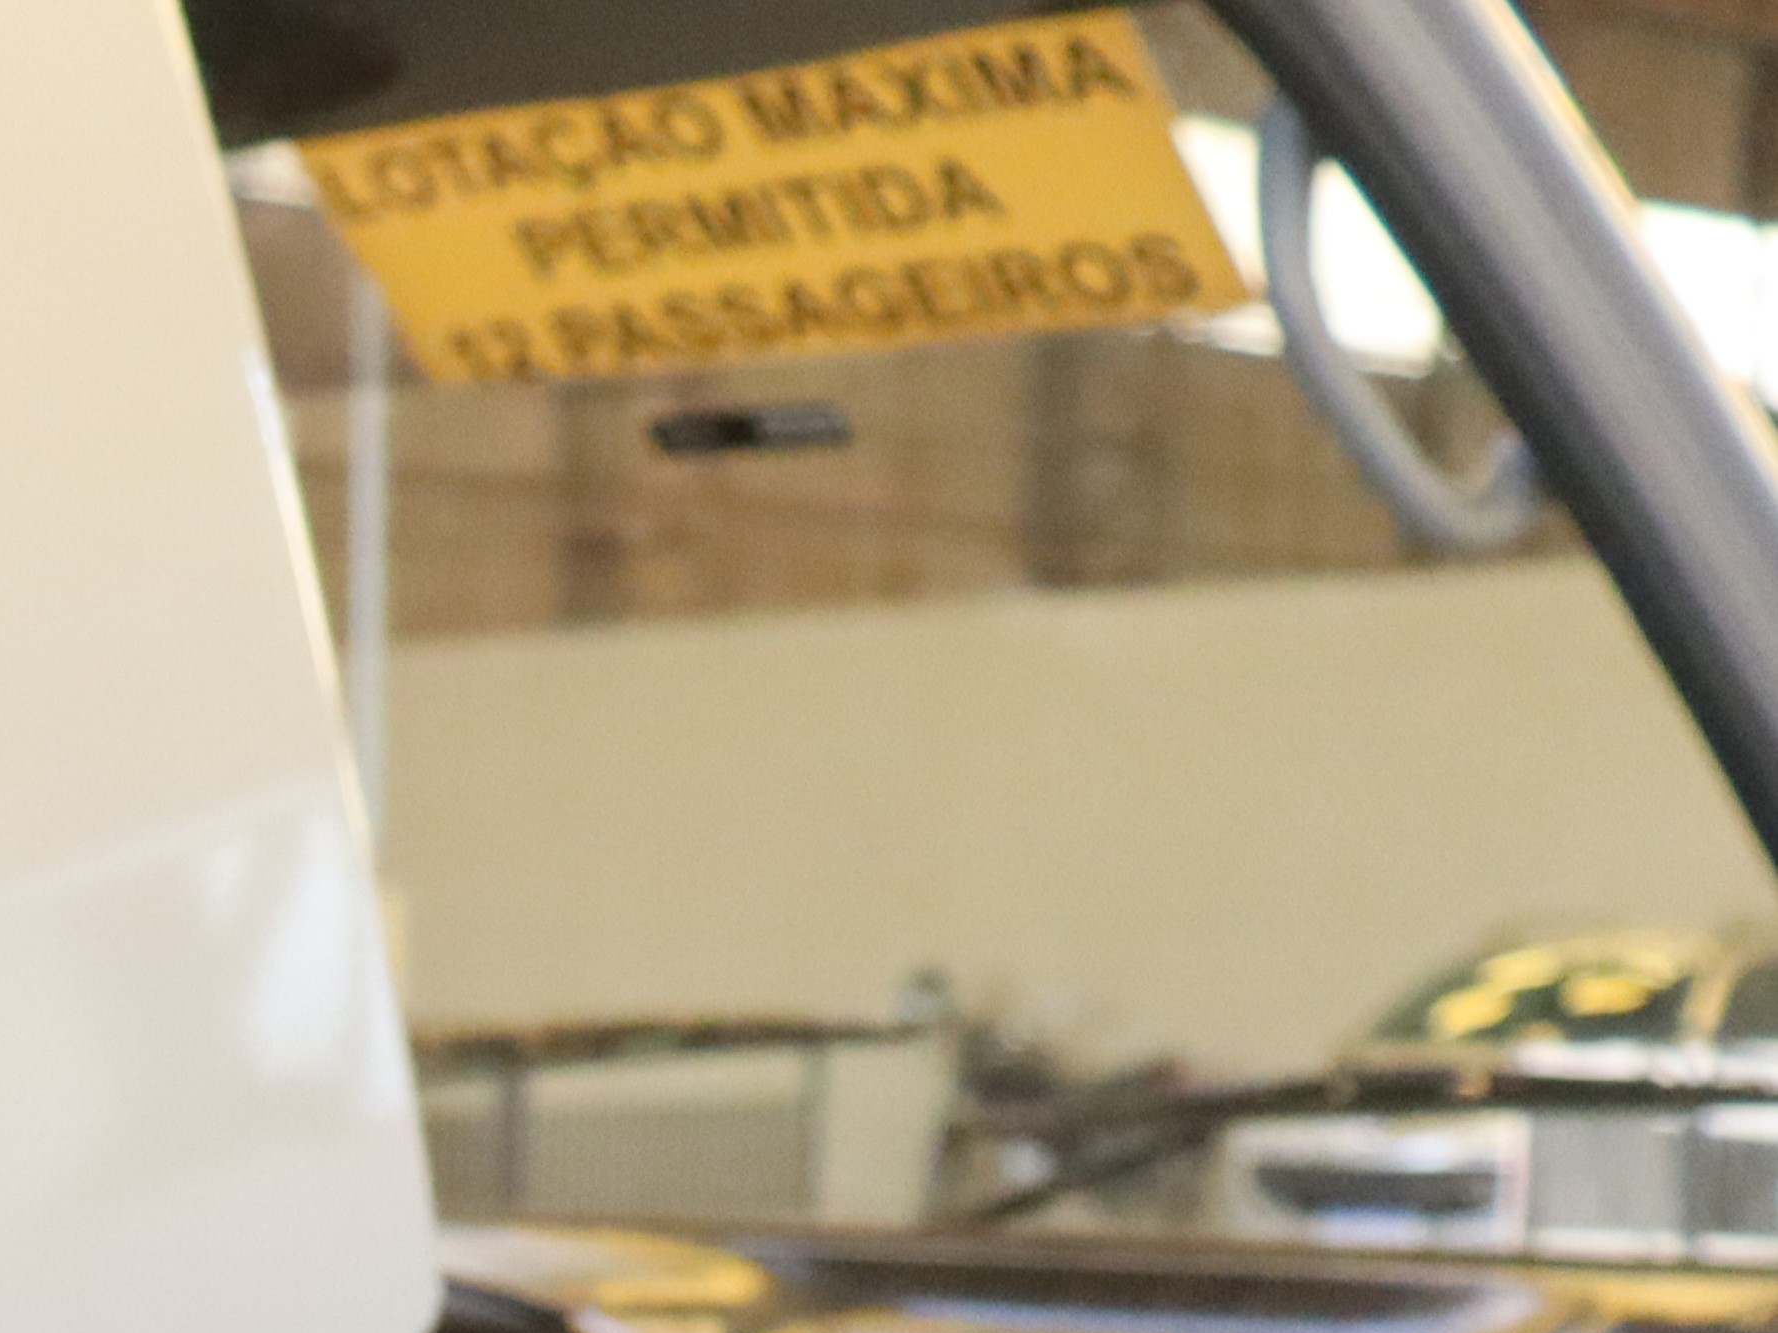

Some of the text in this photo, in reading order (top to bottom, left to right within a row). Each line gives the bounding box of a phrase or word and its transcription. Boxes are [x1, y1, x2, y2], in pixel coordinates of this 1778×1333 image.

[321, 93, 727, 224] LOTAÇÃO
[514, 156, 1006, 281] PERMITIDA
[451, 233, 1201, 385] 12 PASSAGEIROS
